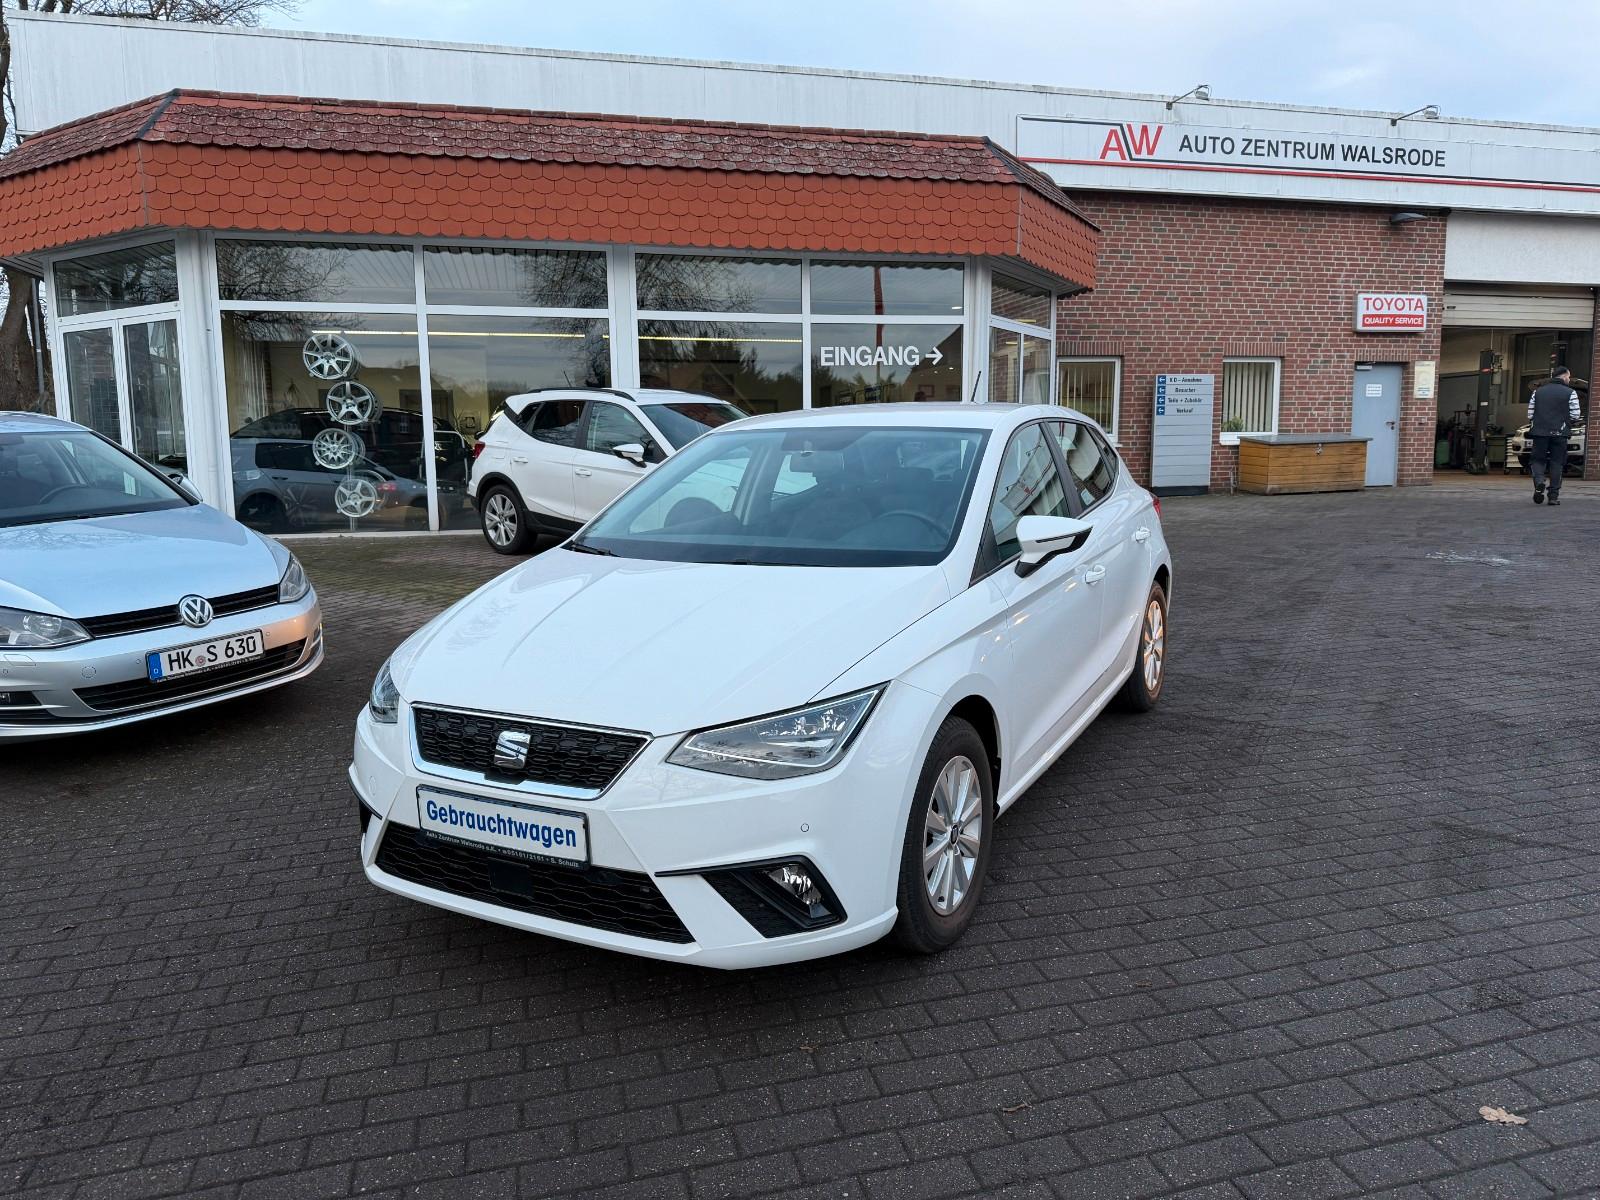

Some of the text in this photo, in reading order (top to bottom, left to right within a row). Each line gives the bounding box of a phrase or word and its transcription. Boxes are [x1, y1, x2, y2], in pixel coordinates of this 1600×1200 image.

[1179, 134, 1446, 167] AUTO ZENTRUM WALSRODE
[1363, 297, 1424, 311] TOYOTA
[1394, 317, 1422, 325] SERVICE
[820, 345, 920, 366] EINGANG
[167, 649, 194, 671] HK
[206, 644, 218, 662] S
[224, 635, 257, 658] 630
[426, 799, 577, 849] Gebrauchtwagen
